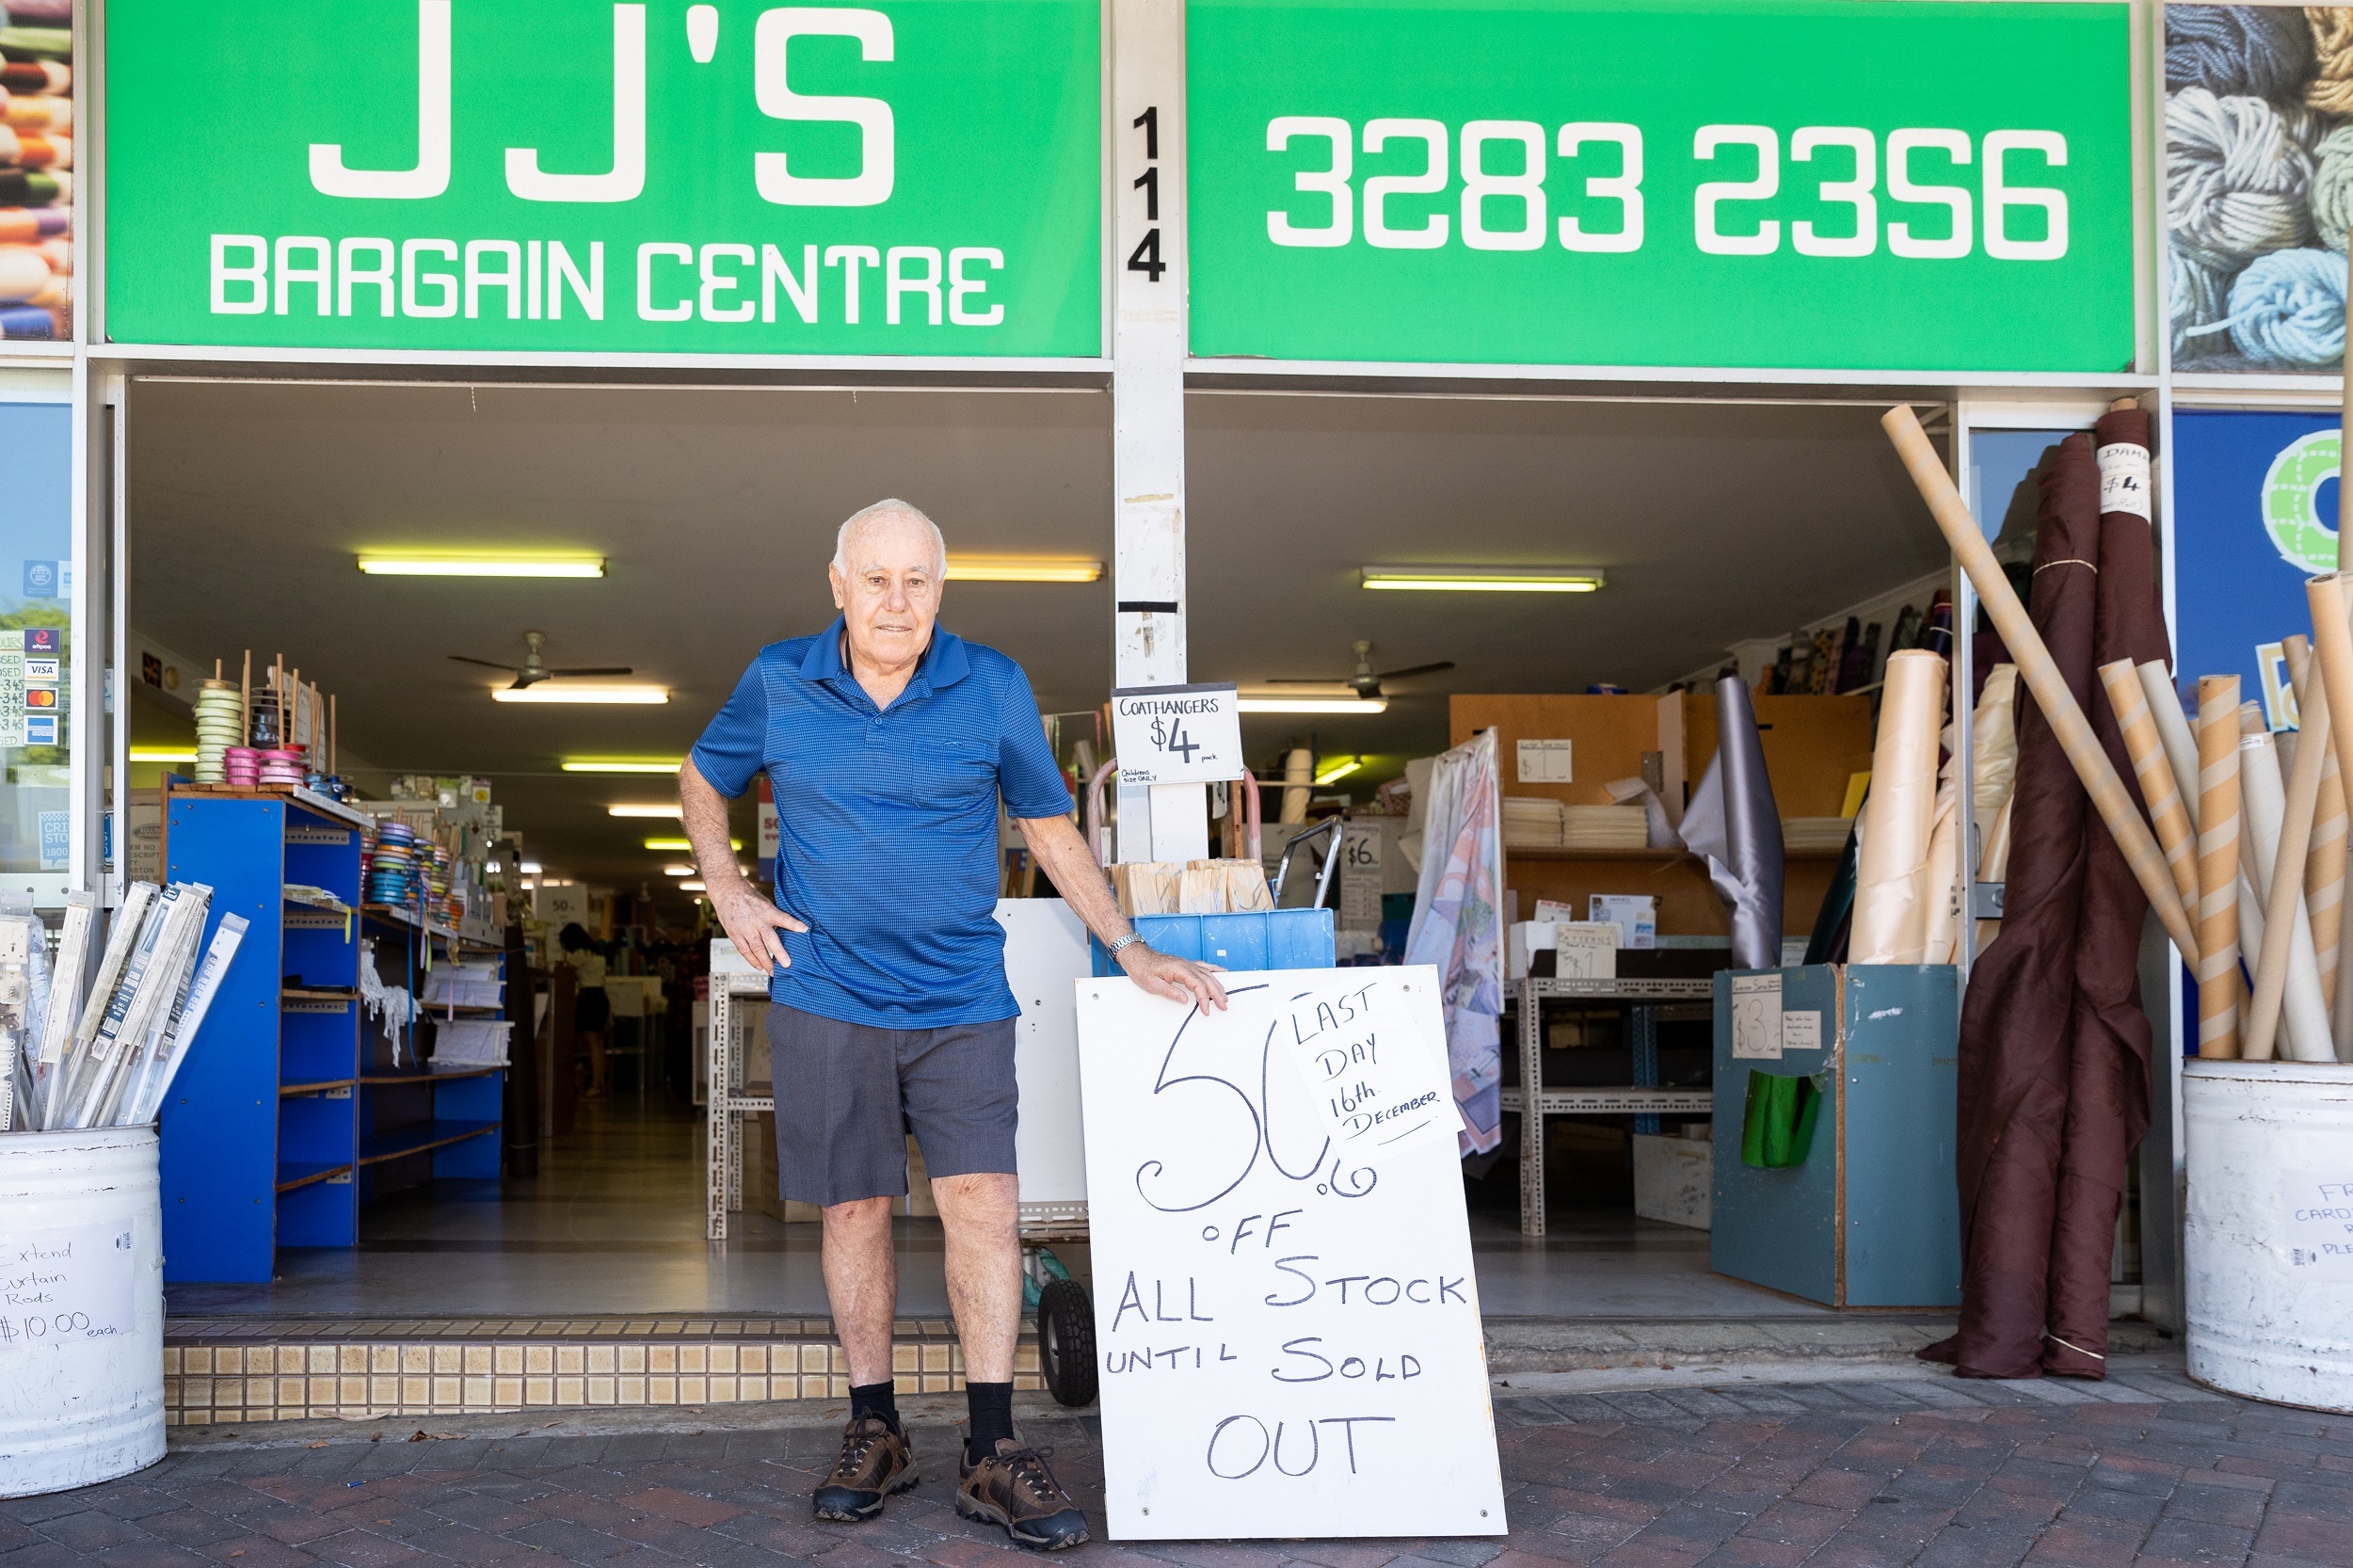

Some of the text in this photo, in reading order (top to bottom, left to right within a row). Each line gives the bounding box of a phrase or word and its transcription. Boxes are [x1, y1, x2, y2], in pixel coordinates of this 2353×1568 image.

[309, 0, 895, 206] JJ'S
[1128, 106, 1167, 282] 114
[1266, 116, 2069, 261] 3283 2356
[210, 233, 1005, 327] BARGAIN CENTRE
[31, 665, 53, 674] VISA
[1119, 697, 1219, 716] COATHANGERS
[1150, 715, 1200, 763] $4
[1292, 983, 1378, 1045] LAST
[1315, 1032, 1377, 1082] DAY
[1342, 1091, 1442, 1141] DECEMBER
[5, 1291, 54, 1306] Rods
[1112, 1256, 1467, 1332] ALL STOCK
[1106, 1337, 1422, 1383] UNTIL SOLD
[1207, 1415, 1396, 1480] OUT
